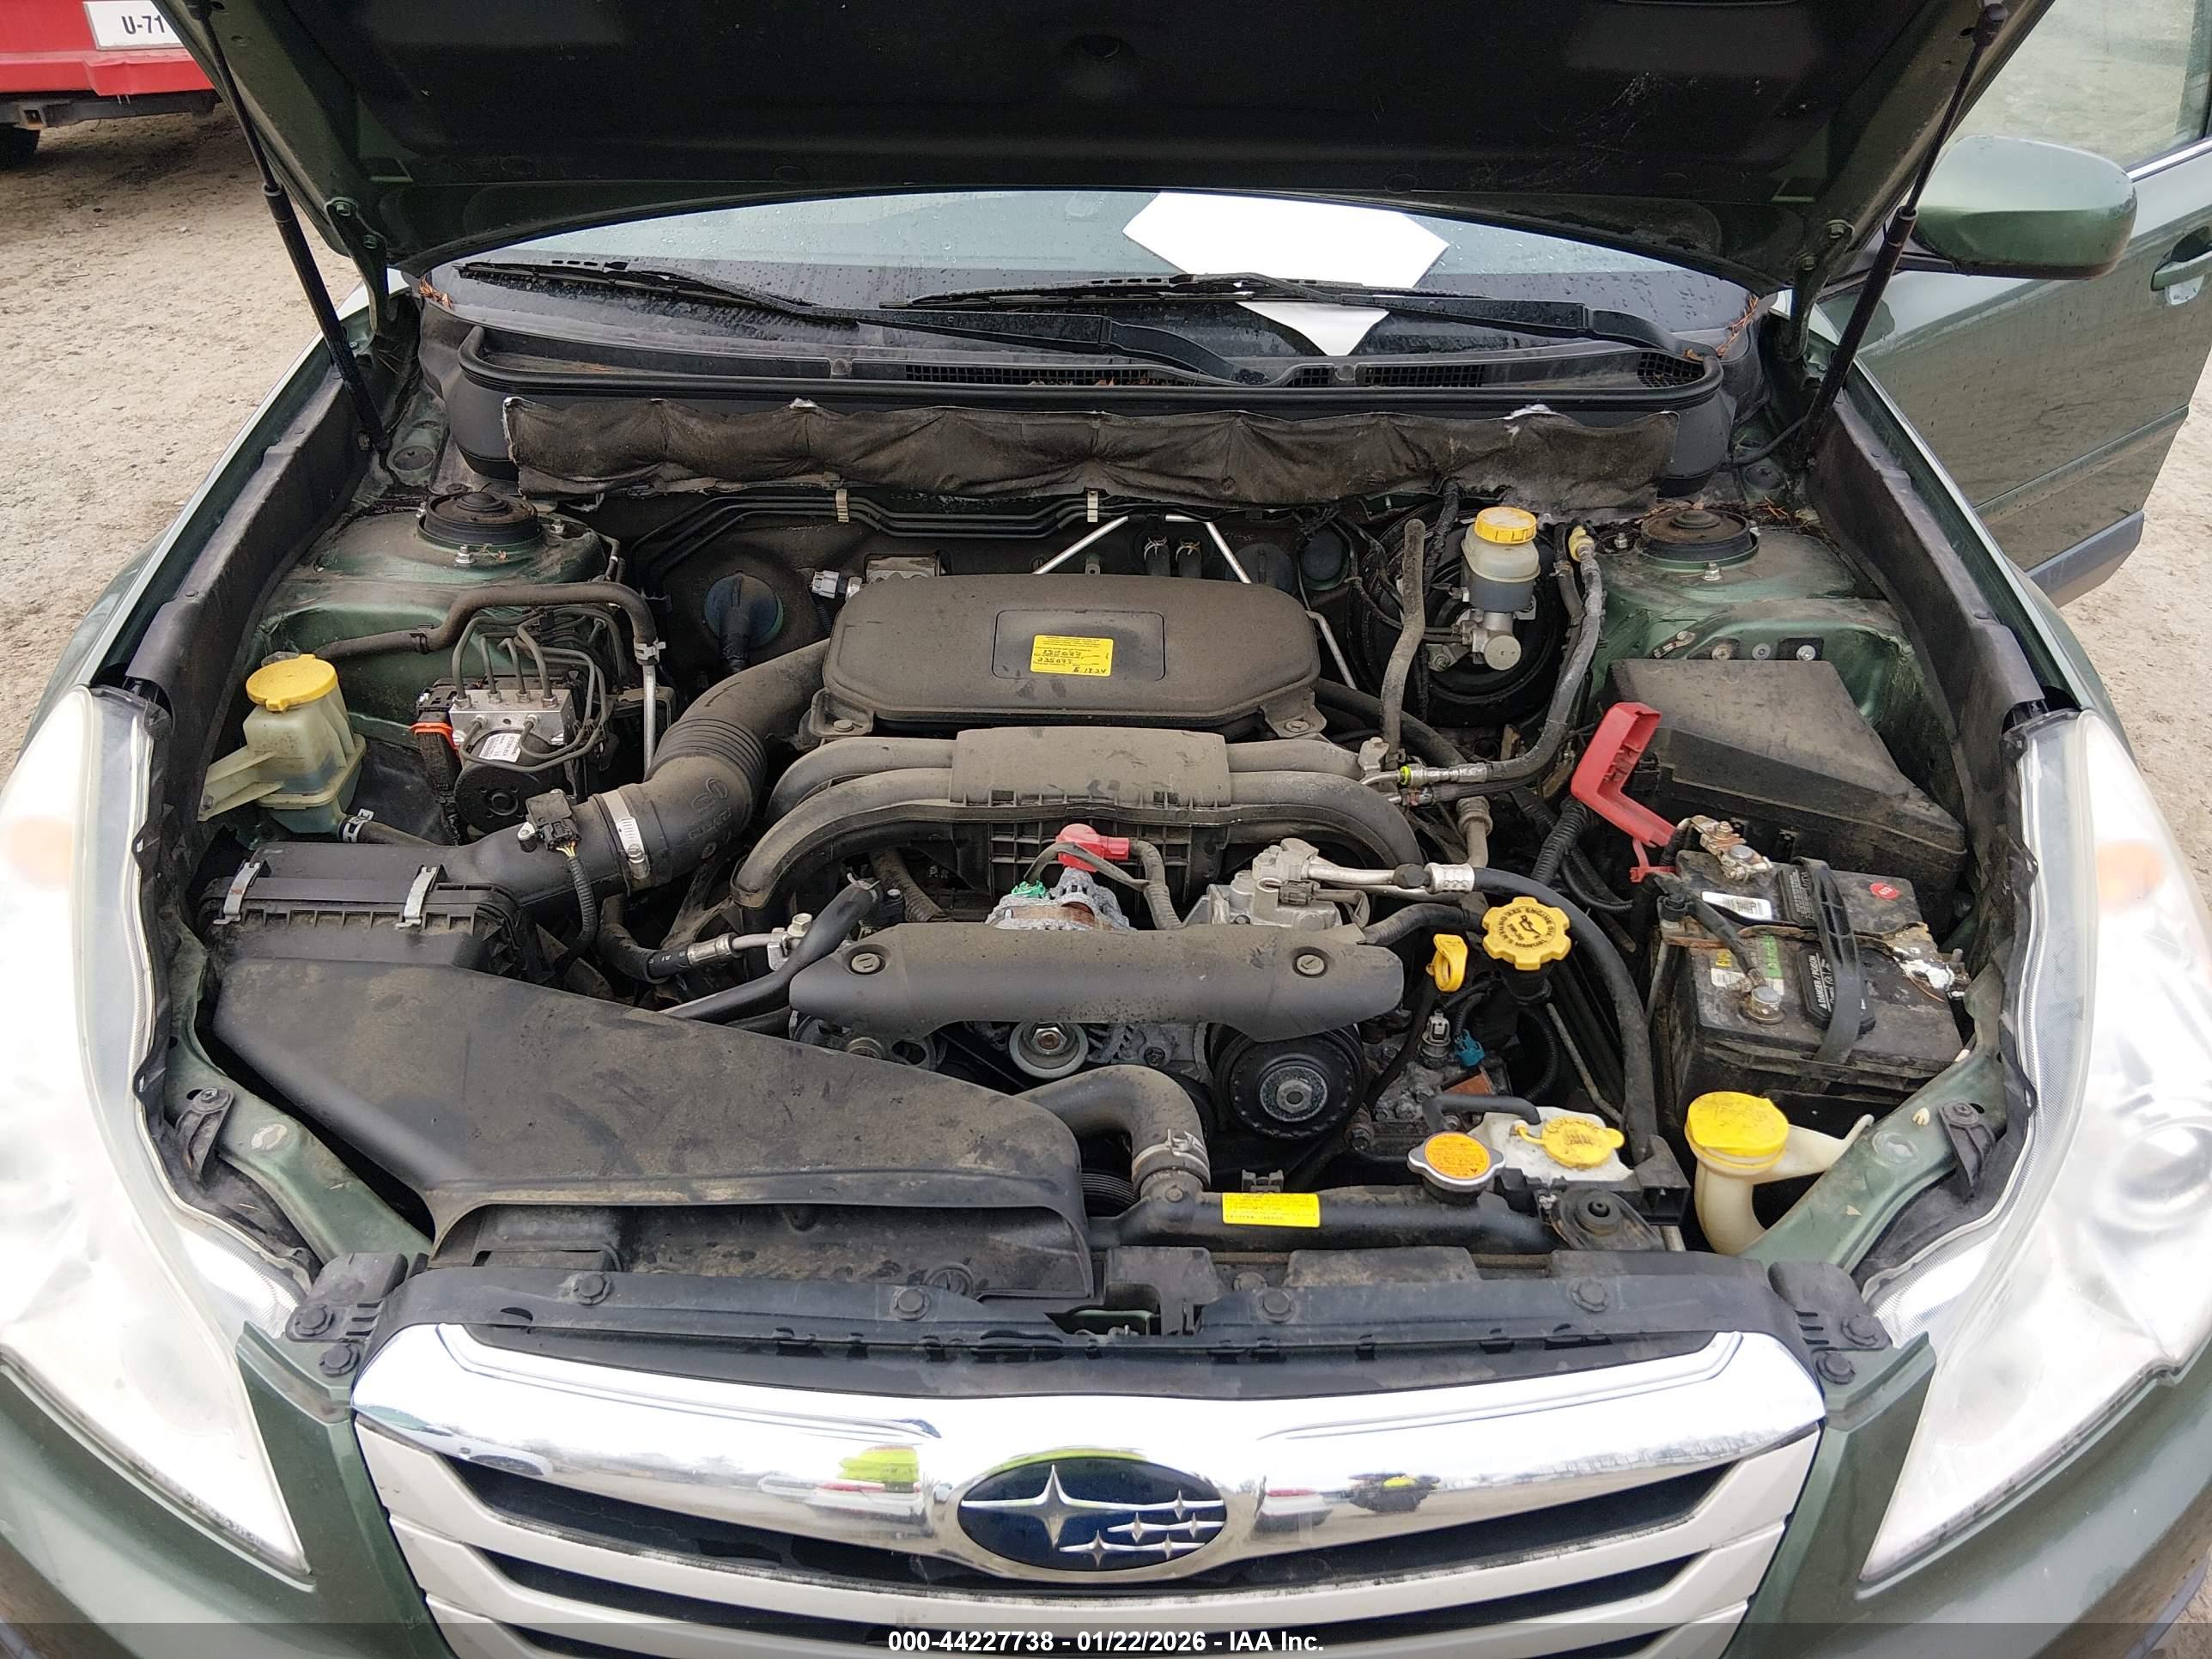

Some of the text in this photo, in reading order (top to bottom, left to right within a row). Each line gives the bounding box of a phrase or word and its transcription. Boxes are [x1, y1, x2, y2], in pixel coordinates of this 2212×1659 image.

[1506, 908, 1522, 916] SEE
[1515, 939, 1547, 948] MANUAL
[1525, 907, 1552, 924] ENGINE
